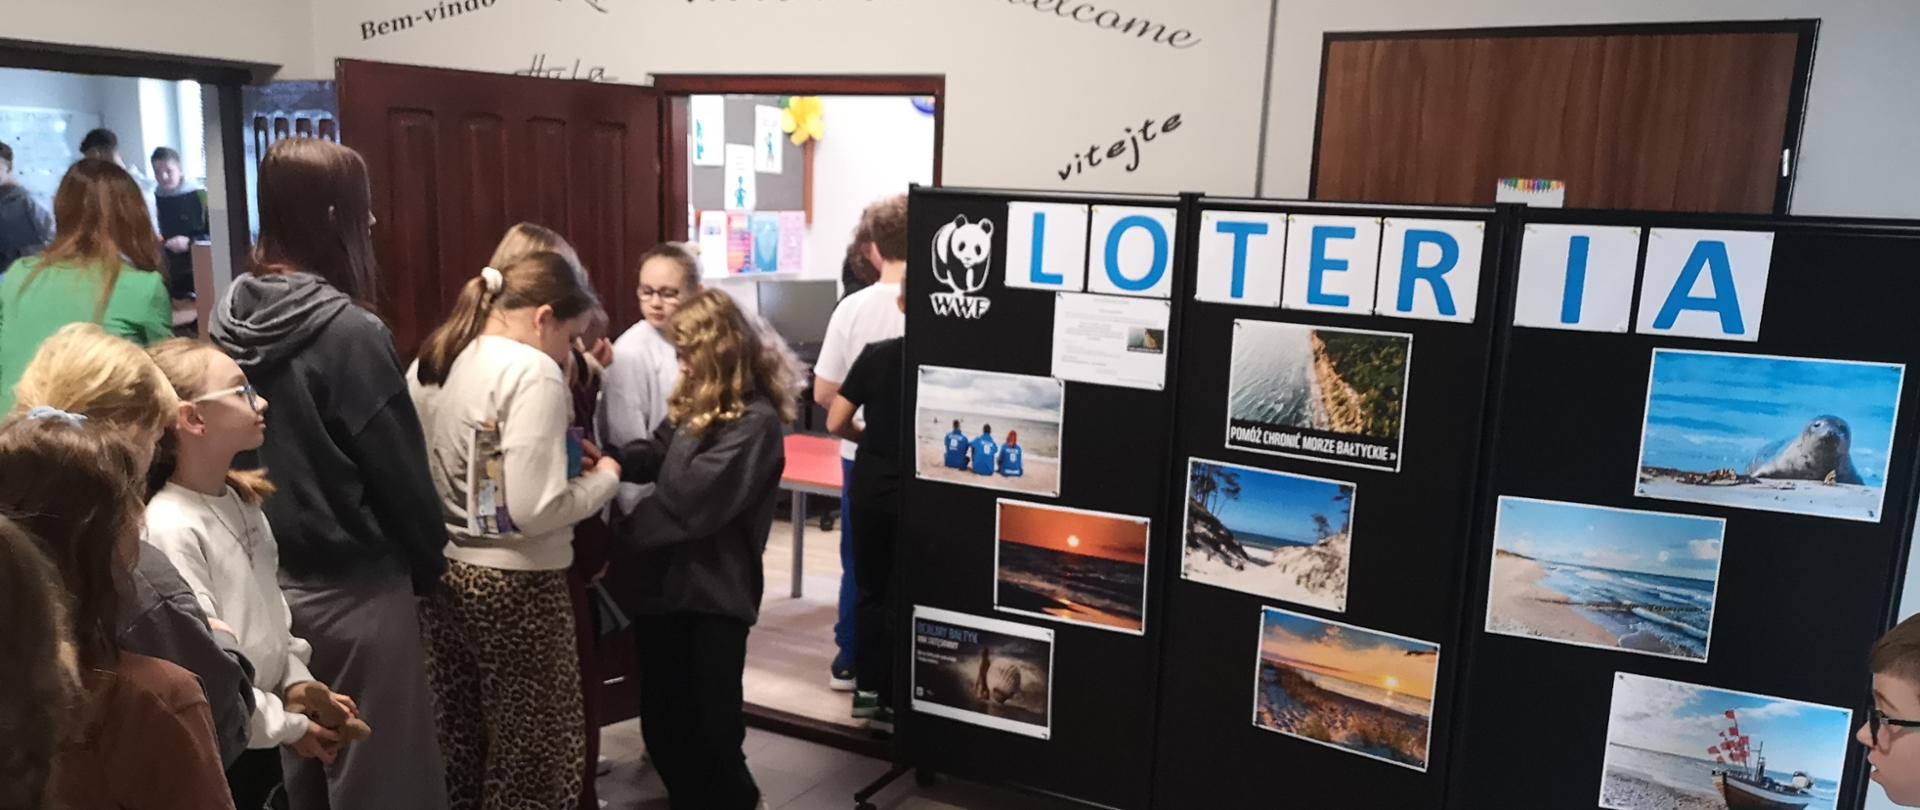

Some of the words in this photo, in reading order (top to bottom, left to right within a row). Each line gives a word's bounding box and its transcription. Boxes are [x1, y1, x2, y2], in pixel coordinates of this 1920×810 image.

[1008, 0, 1202, 48] elcome
[1058, 113, 1182, 180] vitejte
[1030, 212, 1745, 335] LOTERIA
[929, 292, 991, 319] WWF
[1231, 426, 1262, 443] POMÓŻ
[1263, 431, 1301, 448] CHRONIĆ
[1302, 436, 1335, 453] MORZE
[1336, 440, 1388, 460] BAŁTYCKIE
